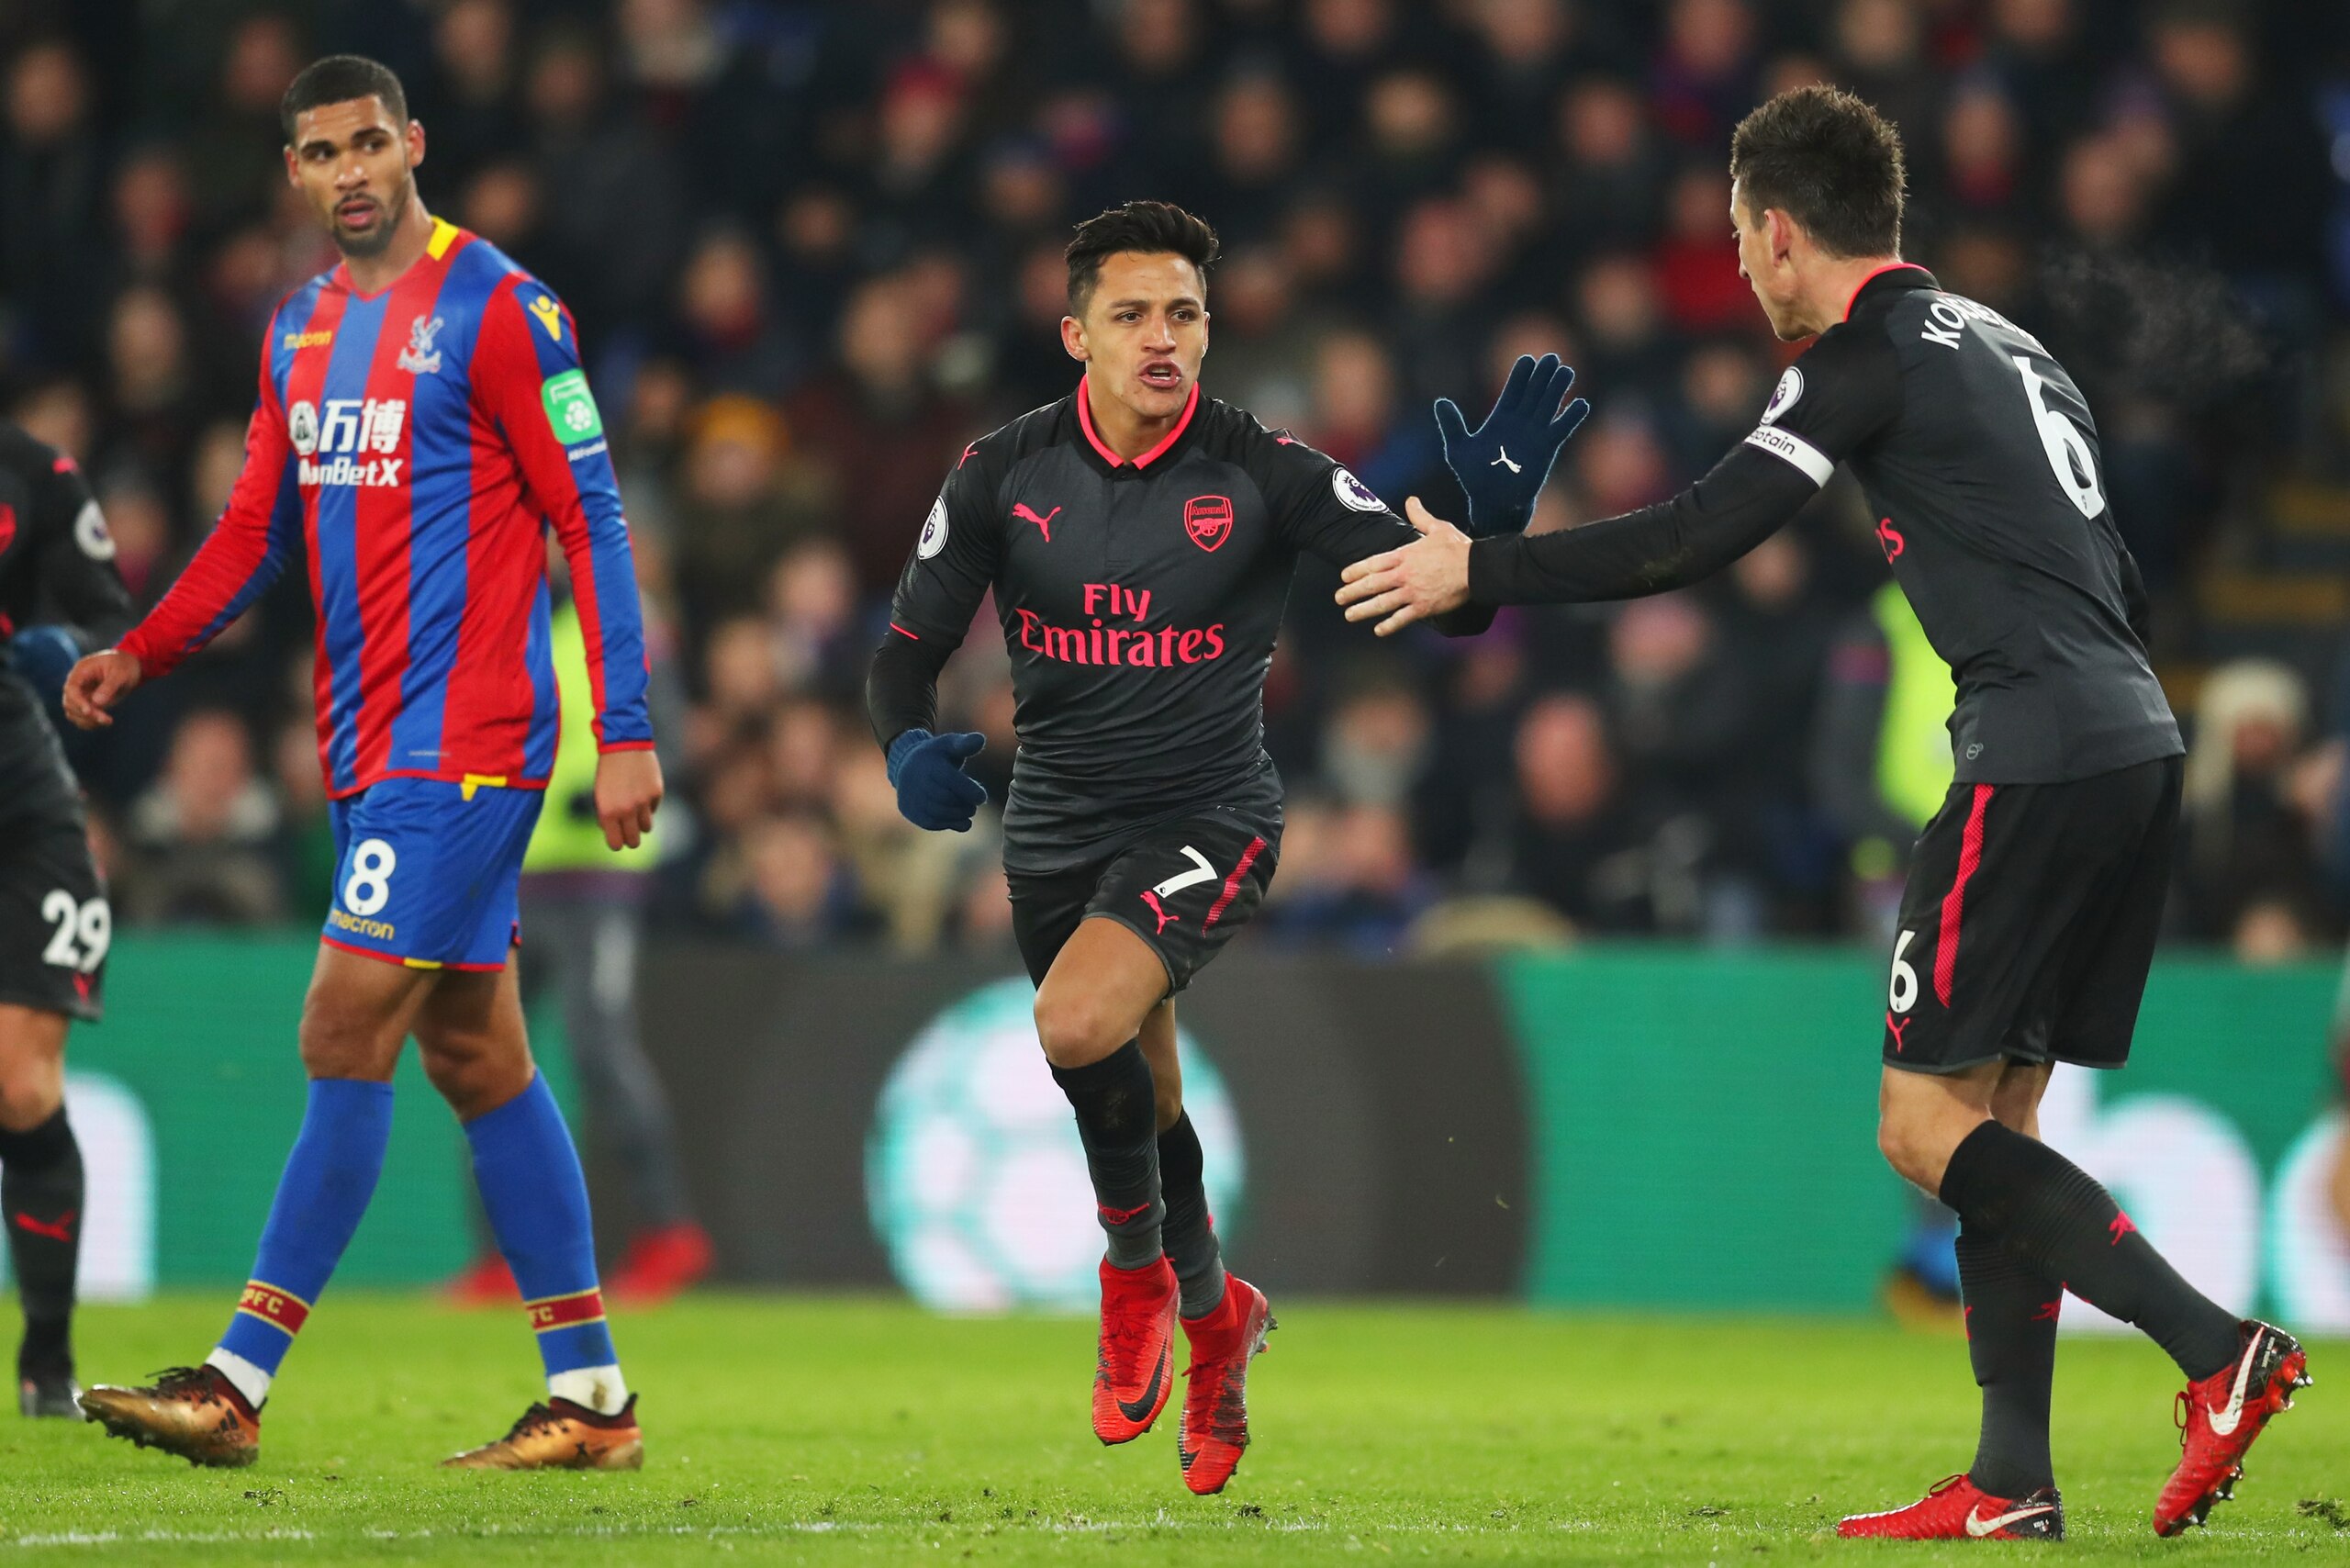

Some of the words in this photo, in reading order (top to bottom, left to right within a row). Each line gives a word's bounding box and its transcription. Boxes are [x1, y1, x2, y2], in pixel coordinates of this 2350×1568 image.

[319, 398, 406, 454] 万博
[2012, 355, 2105, 521] 6
[1083, 583, 1151, 622] Fly
[1015, 607, 1225, 667] Emirates
[344, 837, 397, 916] 8
[1152, 845, 1218, 899] 7
[41, 888, 111, 973] 29
[331, 909, 395, 941] macron
[1889, 929, 1919, 1014] 6
